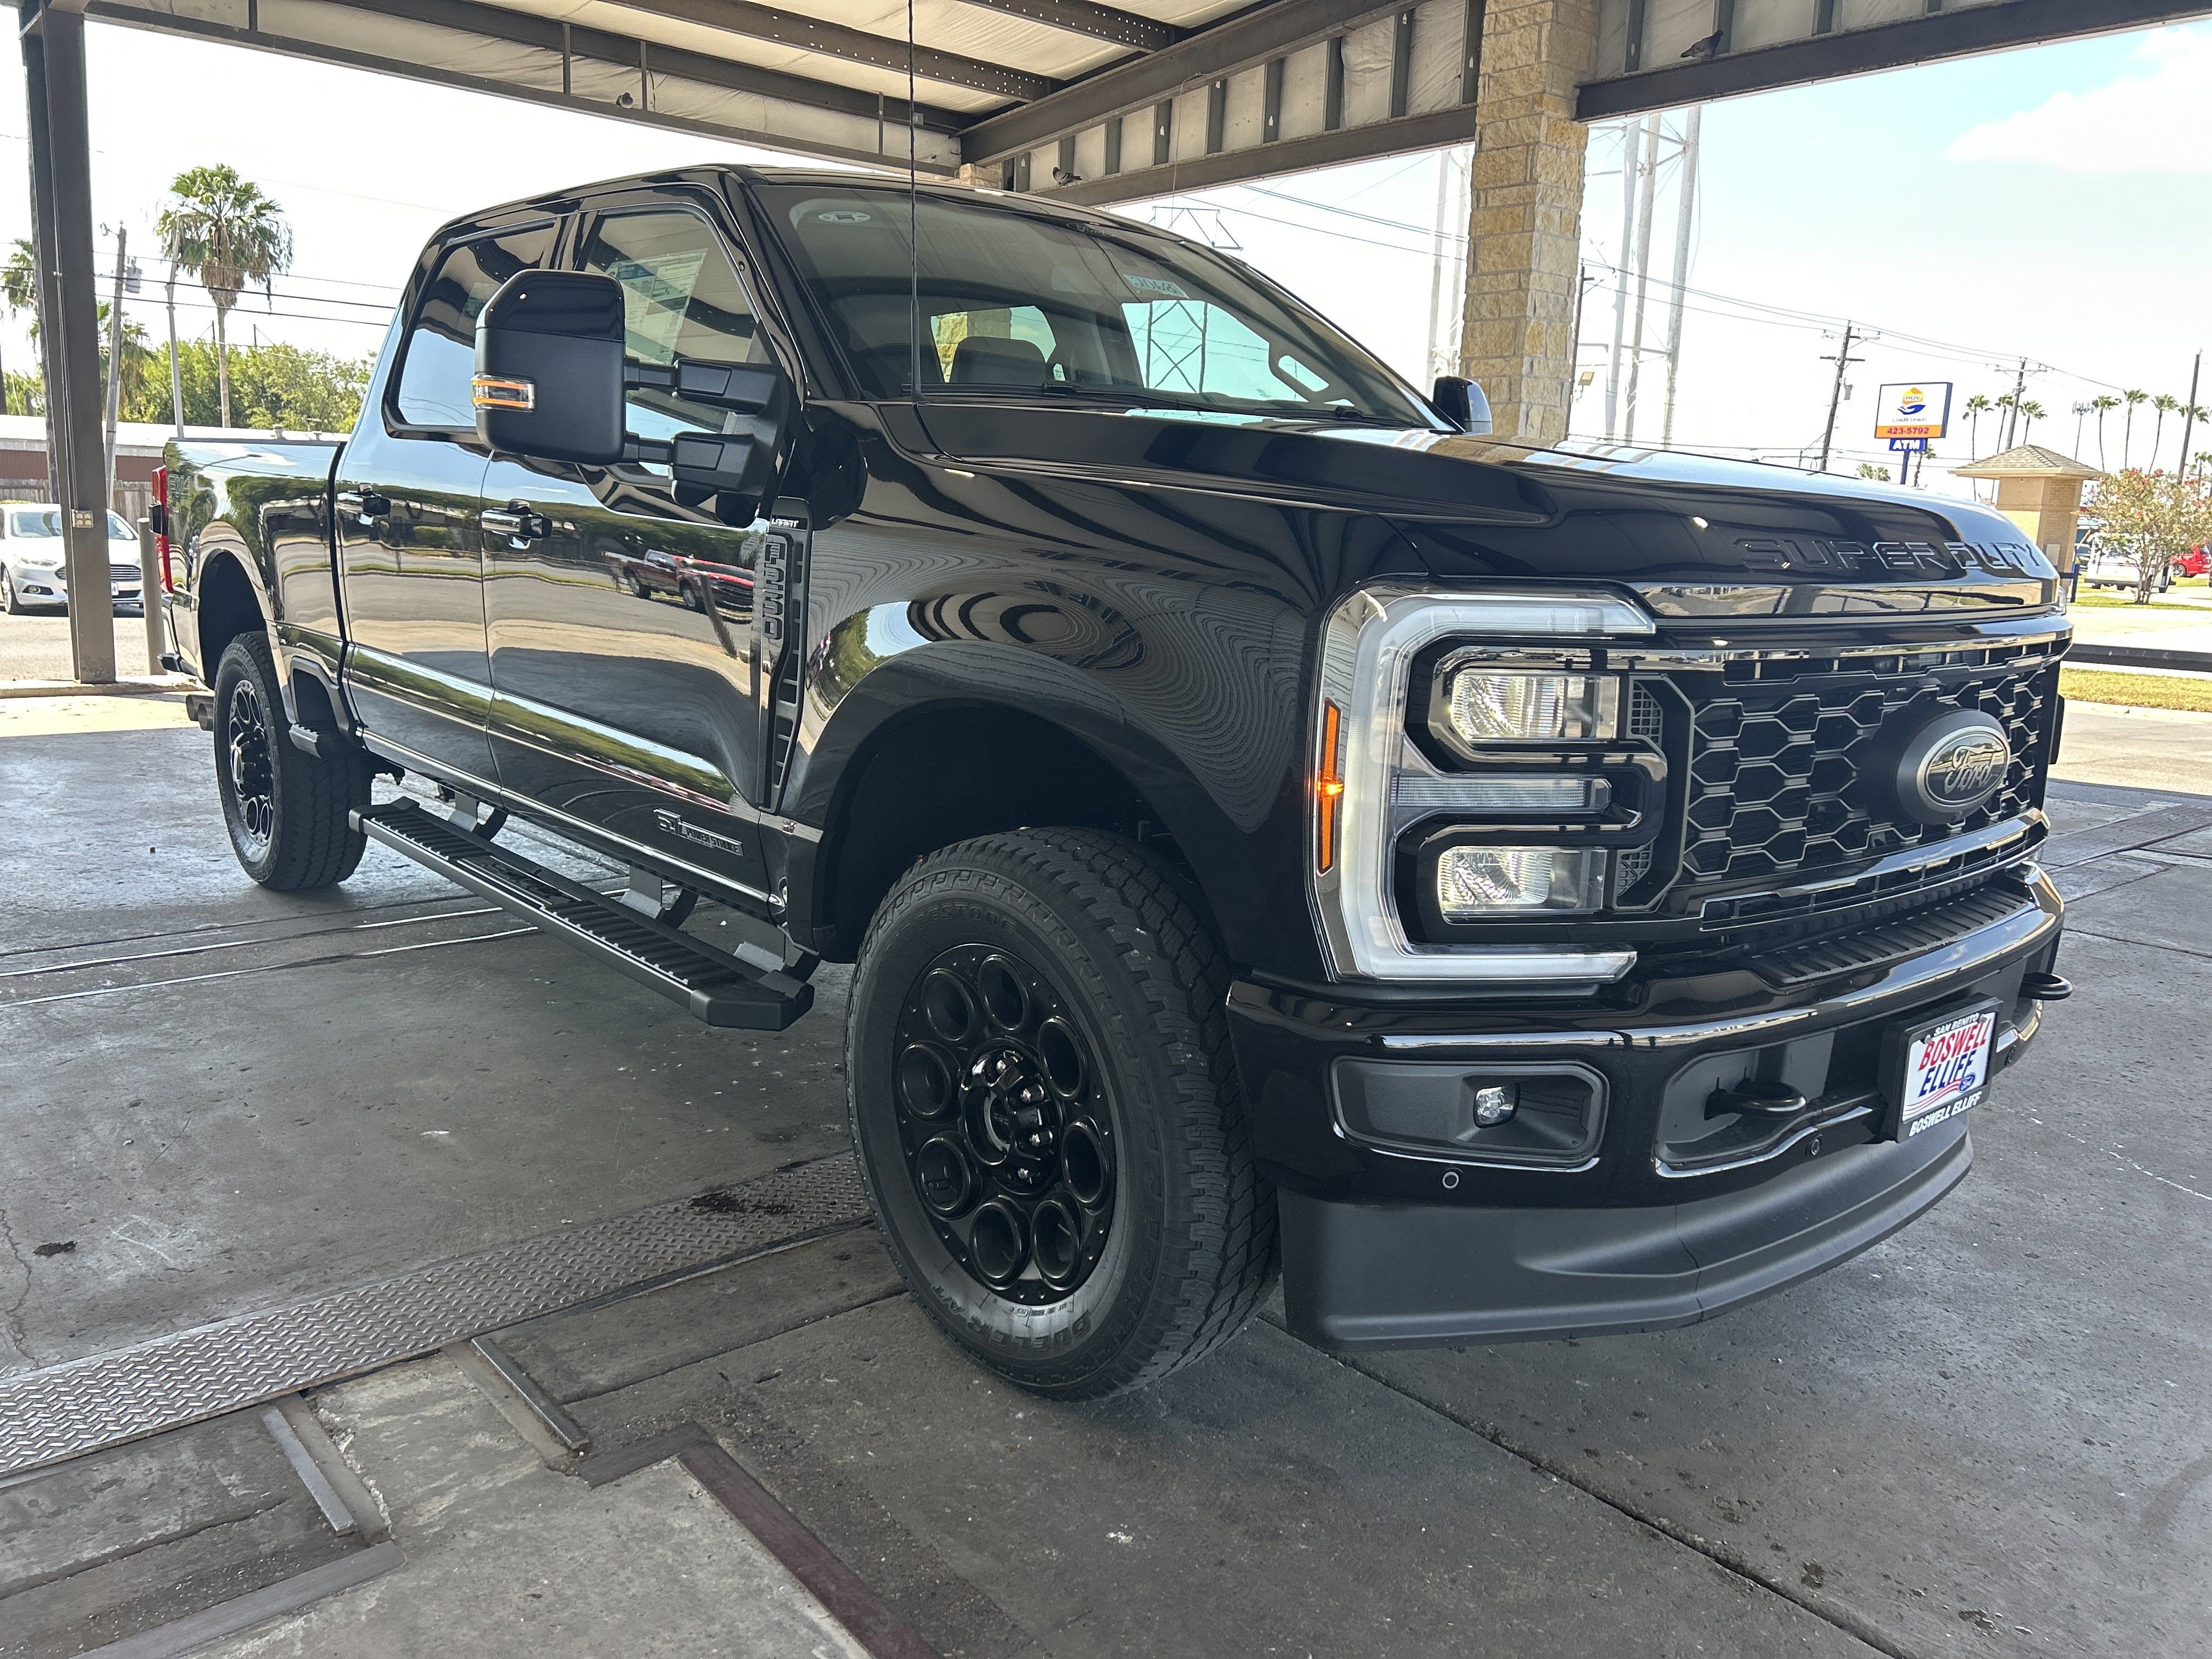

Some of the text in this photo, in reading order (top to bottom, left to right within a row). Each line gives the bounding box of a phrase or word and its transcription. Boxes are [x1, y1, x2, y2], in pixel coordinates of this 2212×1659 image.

[1892, 439, 1921, 450] ATM
[168, 473, 192, 500] FX4
[771, 518, 799, 528] LARIAT
[1733, 538, 2040, 569] SUPER DUTY
[1944, 746, 1997, 794] Ford
[1933, 1013, 1980, 1037] SAN BENITO
[1918, 1019, 1992, 1071] BOSWELL
[1918, 1050, 1977, 1098] ELLIFF
[1909, 1091, 1983, 1137] BOSWELL ELLIFF
